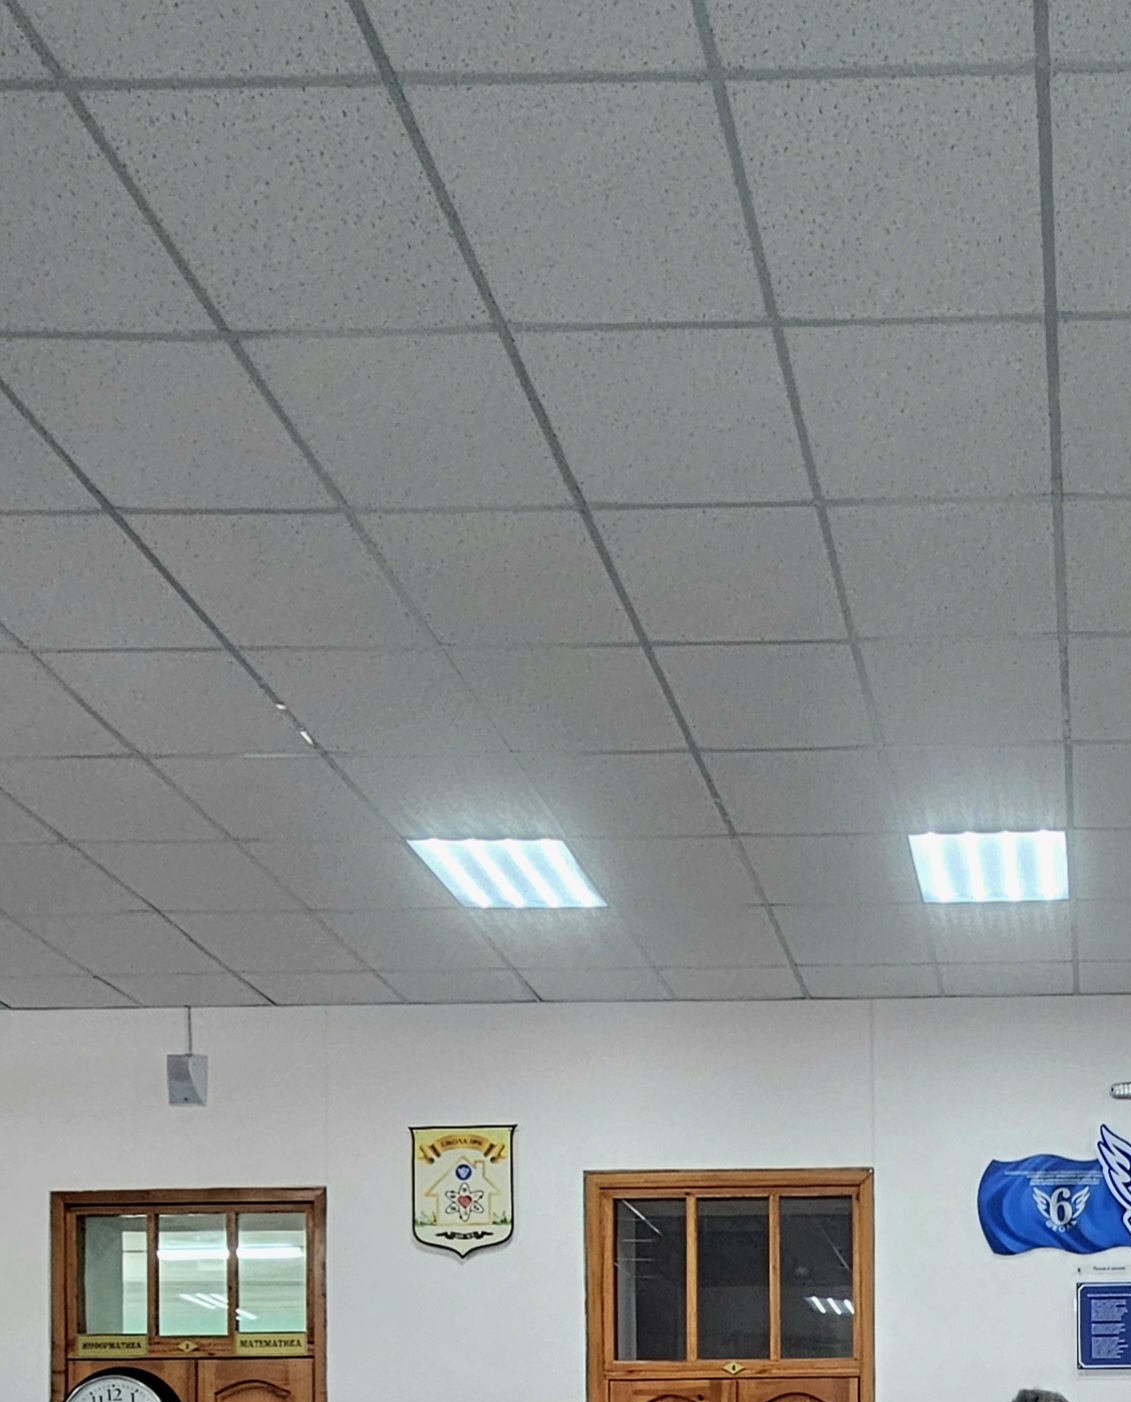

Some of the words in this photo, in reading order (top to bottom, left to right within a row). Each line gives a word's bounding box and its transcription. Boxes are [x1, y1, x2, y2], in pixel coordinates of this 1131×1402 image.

[1049, 1187, 1073, 1227] 6
[82, 1341, 142, 1350] ИНФОРМАТИКА
[239, 1338, 302, 1349] МАТЕМАТИКА
[107, 1388, 123, 1402] 12
